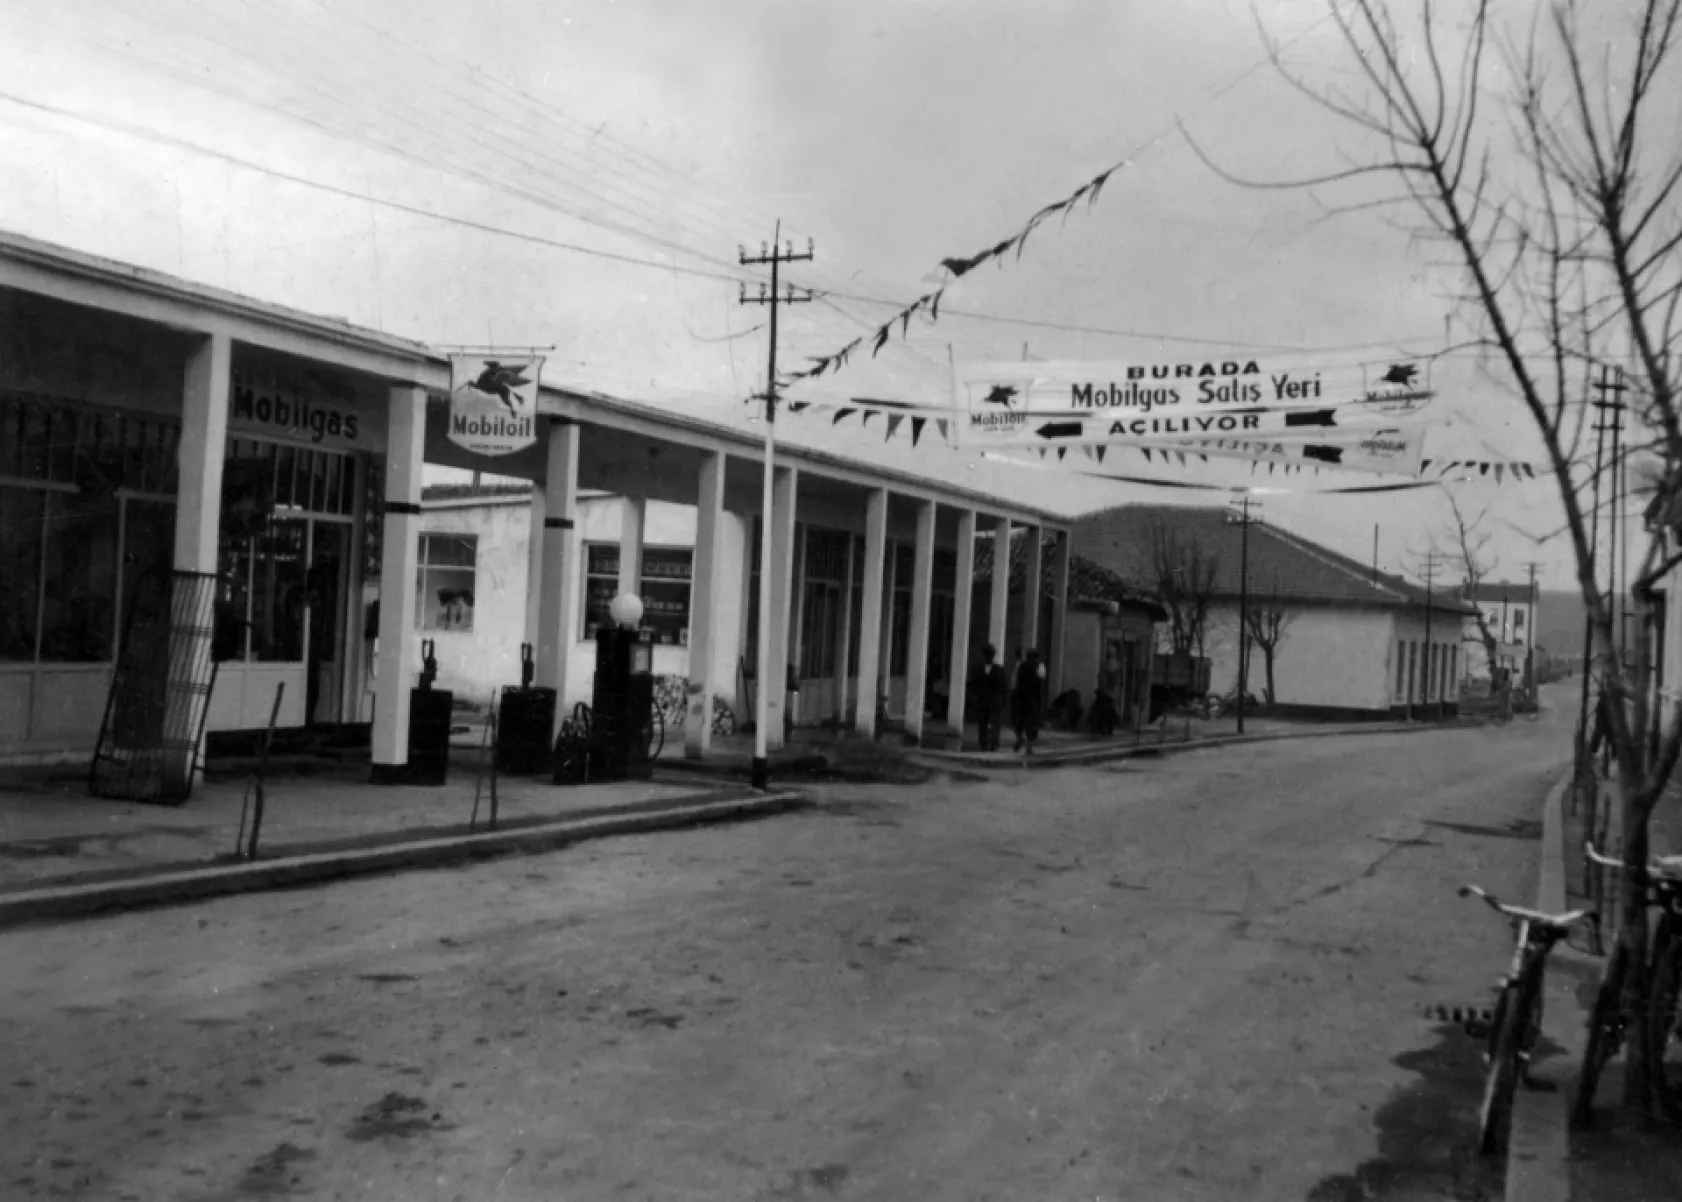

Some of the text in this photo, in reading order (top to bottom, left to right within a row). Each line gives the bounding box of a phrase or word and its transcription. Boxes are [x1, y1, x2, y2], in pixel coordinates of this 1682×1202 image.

[1127, 360, 1260, 379] BURADA
[1071, 381, 1181, 412] Mobilgas
[1271, 371, 1322, 400] Yeri
[233, 386, 358, 443] Mobilgas
[453, 413, 532, 437] Mobiloil
